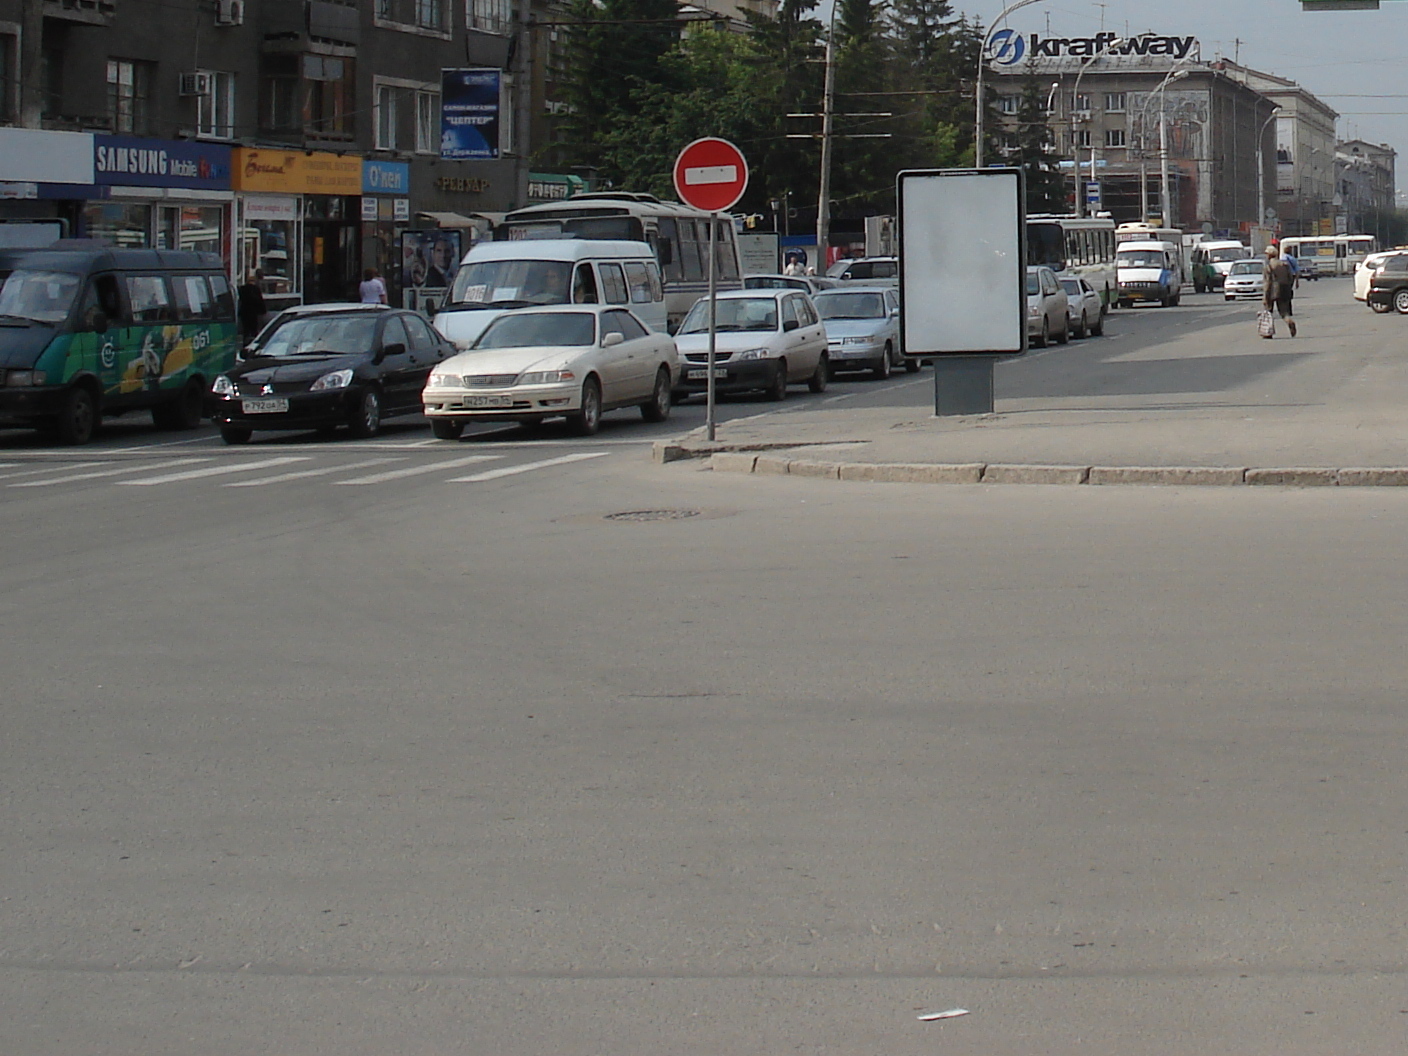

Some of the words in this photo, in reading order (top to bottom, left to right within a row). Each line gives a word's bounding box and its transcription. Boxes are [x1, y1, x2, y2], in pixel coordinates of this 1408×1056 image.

[1030, 32, 1195, 59] kraftway
[446, 116, 494, 125] "ЦЕПТЕР"
[97, 146, 168, 175] SAMSUNG
[170, 158, 198, 177] Mobile
[192, 330, 210, 350] 061
